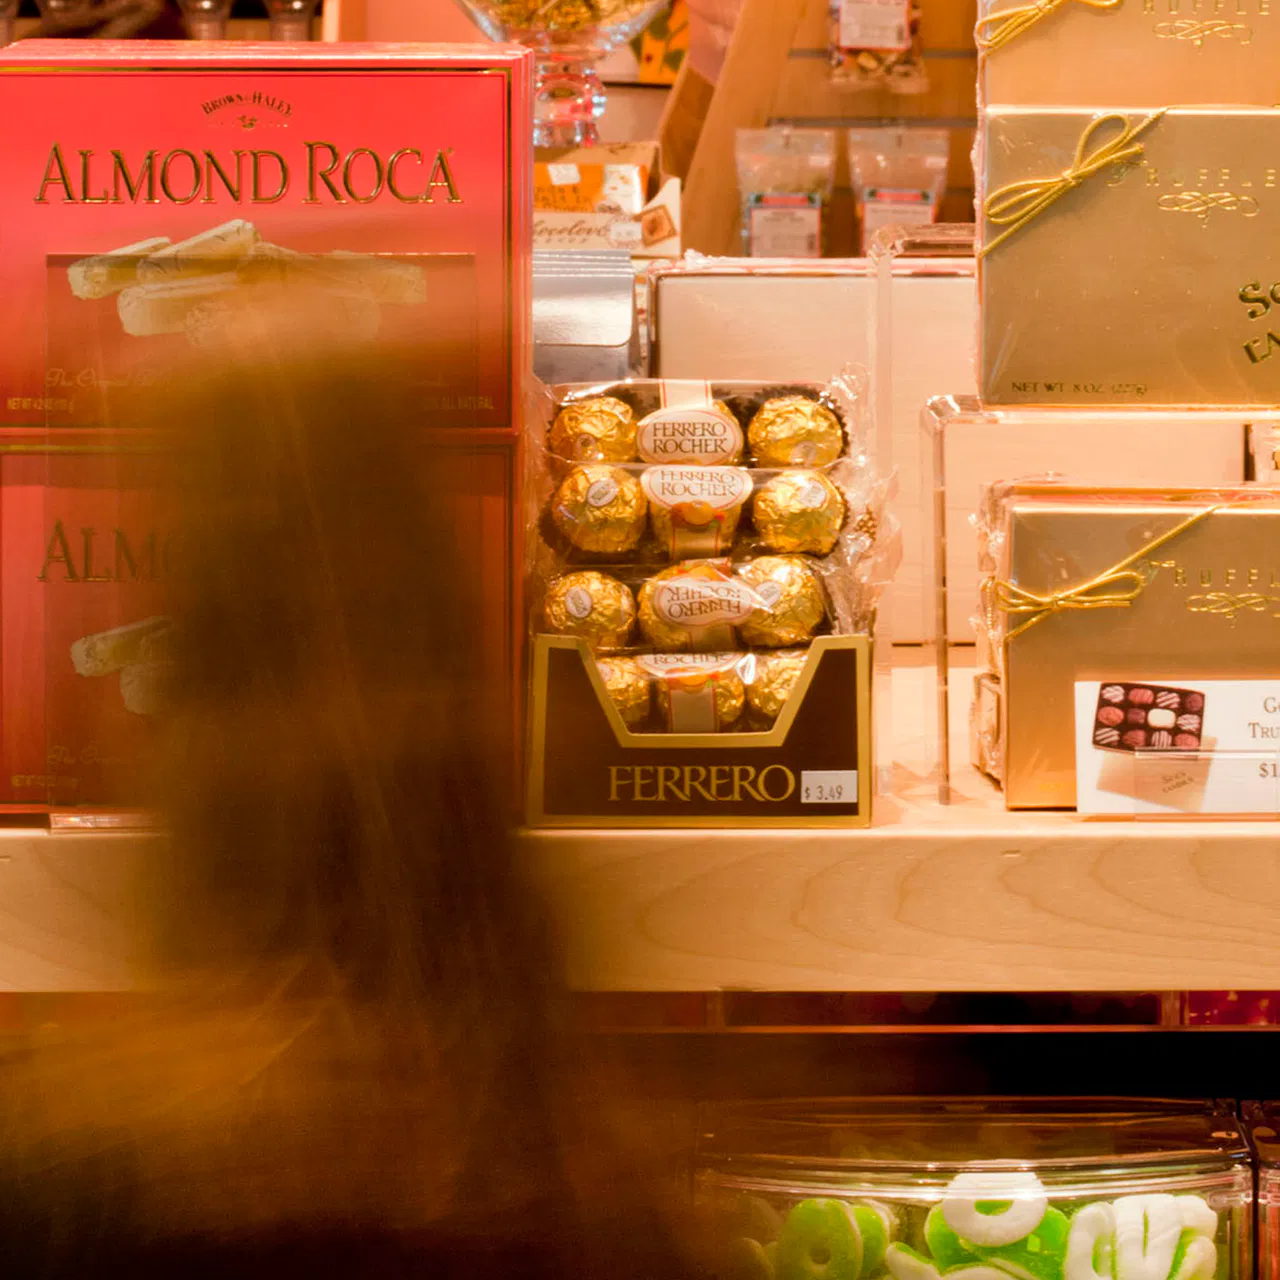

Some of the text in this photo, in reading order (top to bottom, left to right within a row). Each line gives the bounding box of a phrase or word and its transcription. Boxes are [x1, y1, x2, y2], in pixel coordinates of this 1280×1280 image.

[33, 141, 290, 207] ALMOND
[302, 139, 465, 207] ROCA
[1011, 381, 1040, 394] NET
[653, 422, 727, 437] FERRERO
[653, 437, 728, 454] ROCHER
[660, 482, 737, 497] ROCHER
[609, 764, 795, 802] FERRERO
[804, 785, 844, 801] $ 3.49
